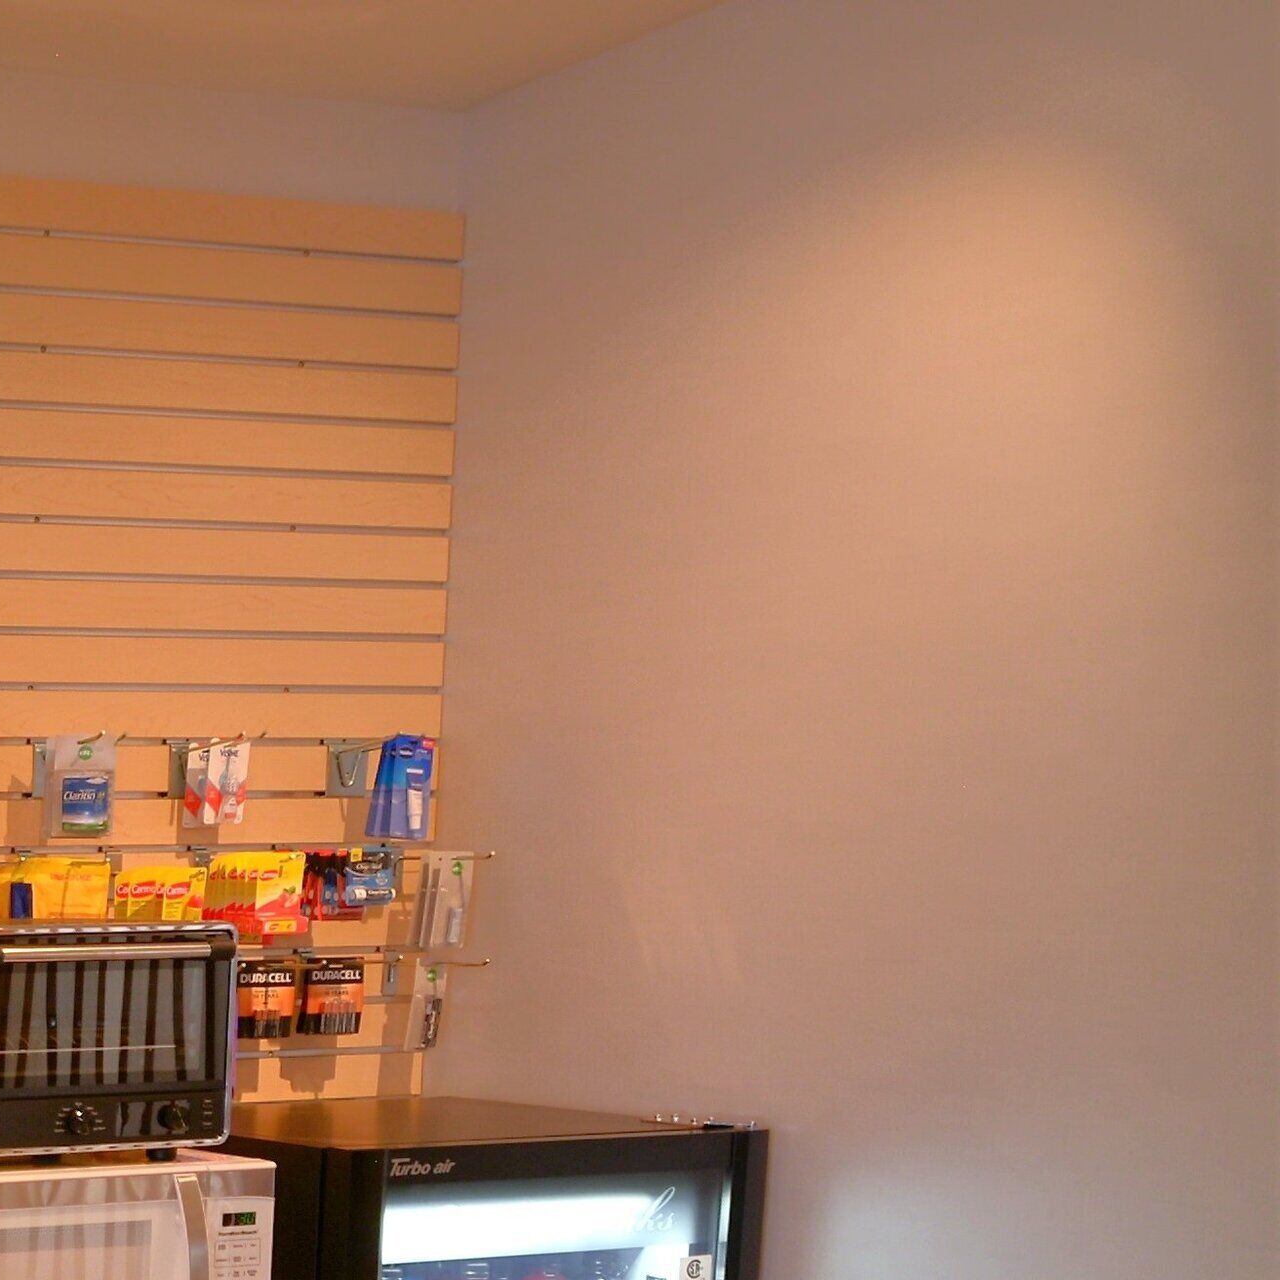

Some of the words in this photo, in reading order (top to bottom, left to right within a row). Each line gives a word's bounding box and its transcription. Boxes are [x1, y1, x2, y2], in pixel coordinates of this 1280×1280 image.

[312, 970, 361, 980] DURACELL
[389, 1158, 431, 1176] Turbo
[434, 1159, 455, 1175] air
